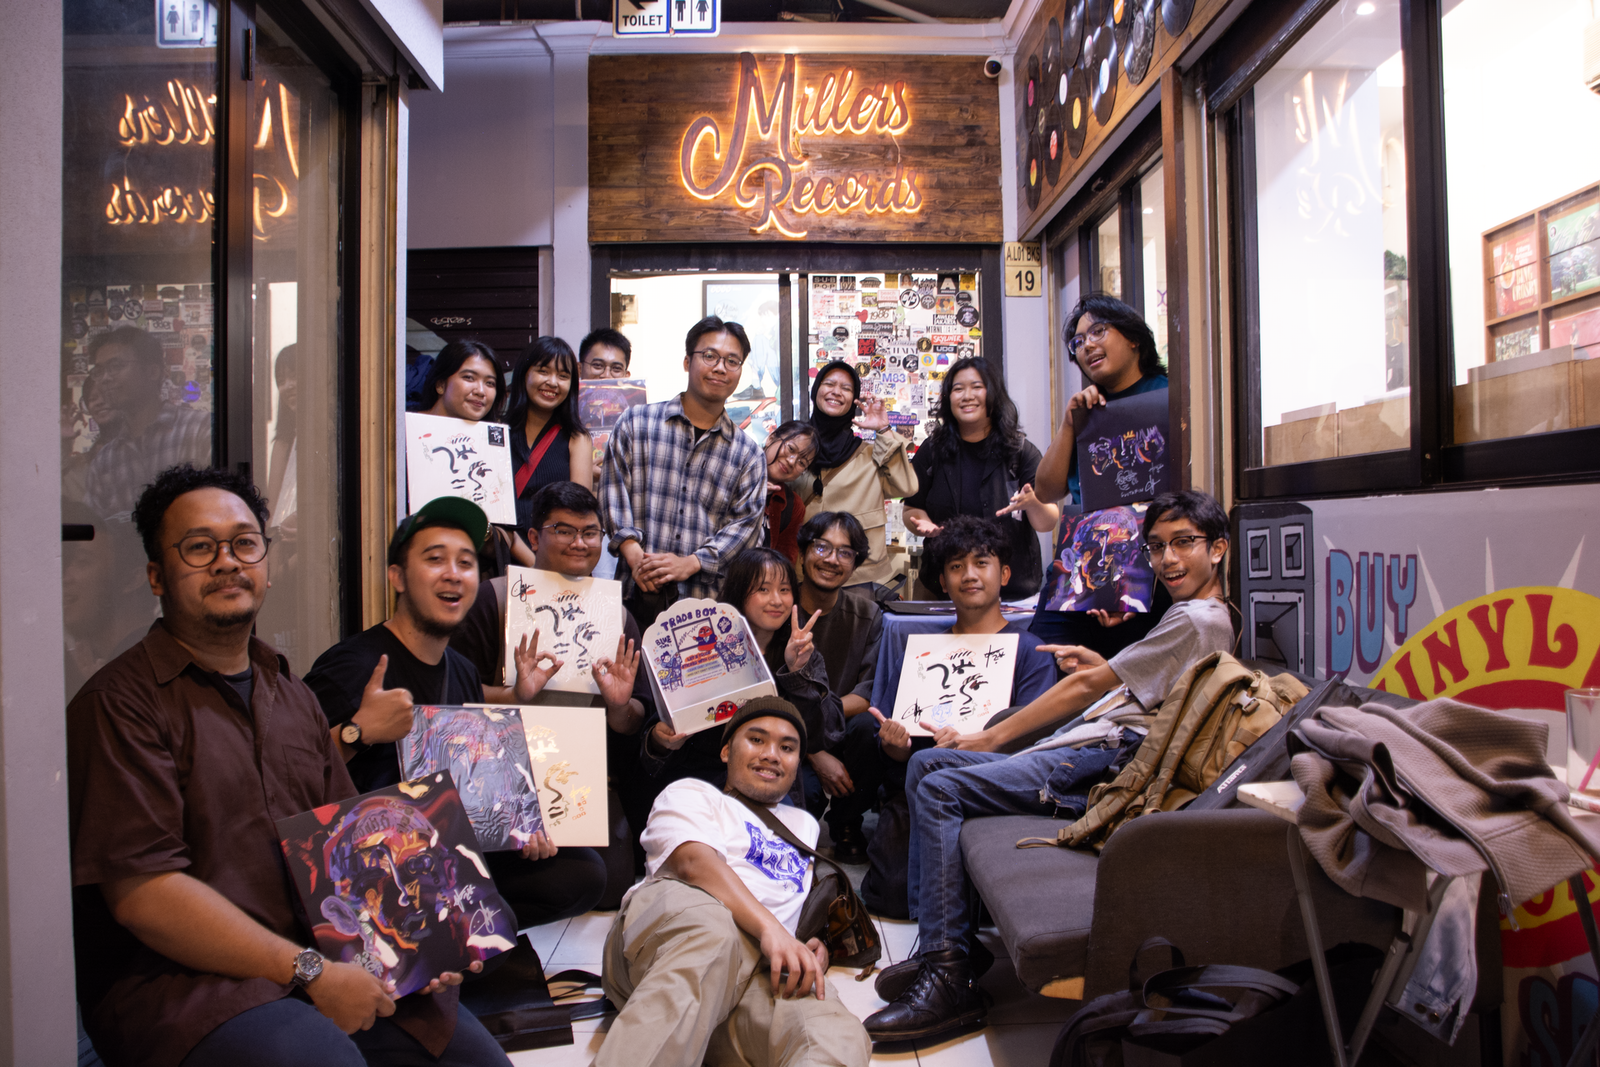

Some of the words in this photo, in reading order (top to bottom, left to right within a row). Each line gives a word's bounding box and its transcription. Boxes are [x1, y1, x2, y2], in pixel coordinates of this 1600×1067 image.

[622, 14, 664, 27] TOILET
[680, 51, 910, 200] Millers
[736, 157, 923, 238] Records
[1027, 246, 1041, 262] BKS
[1015, 270, 1035, 292] 19
[882, 373, 906, 383] M83
[695, 606, 718, 619] BOX
[1326, 548, 1418, 680] BUY
[1377, 593, 1579, 702] INYL
